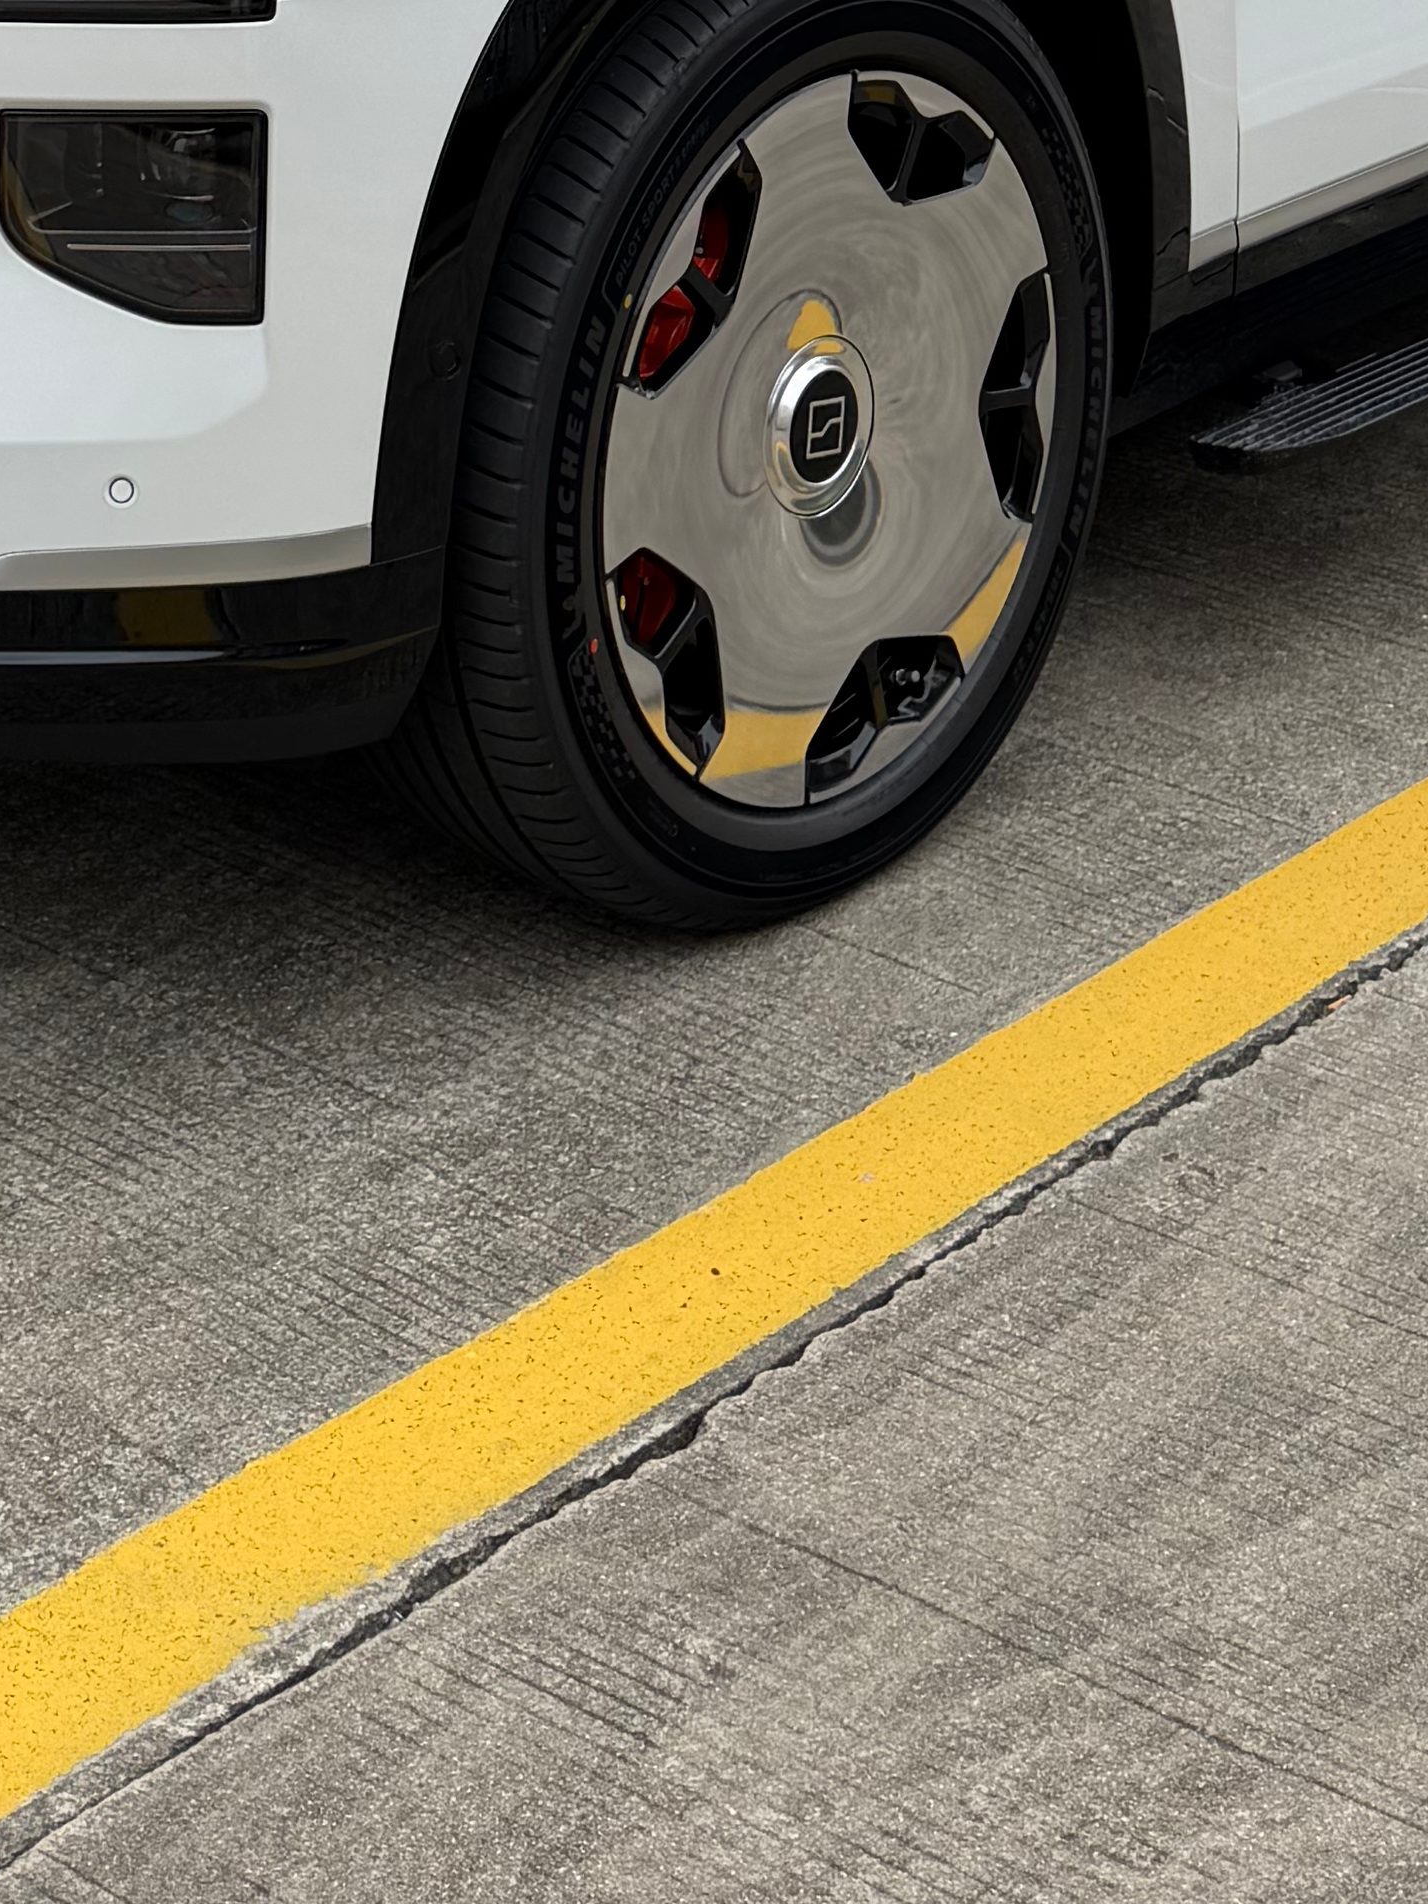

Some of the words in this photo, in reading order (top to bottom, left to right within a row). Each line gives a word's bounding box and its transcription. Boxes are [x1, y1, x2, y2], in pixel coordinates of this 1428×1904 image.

[615, 228, 644, 287] PILOT
[555, 312, 608, 585] MICHELIN
[1067, 305, 1105, 542] MICHELIN
